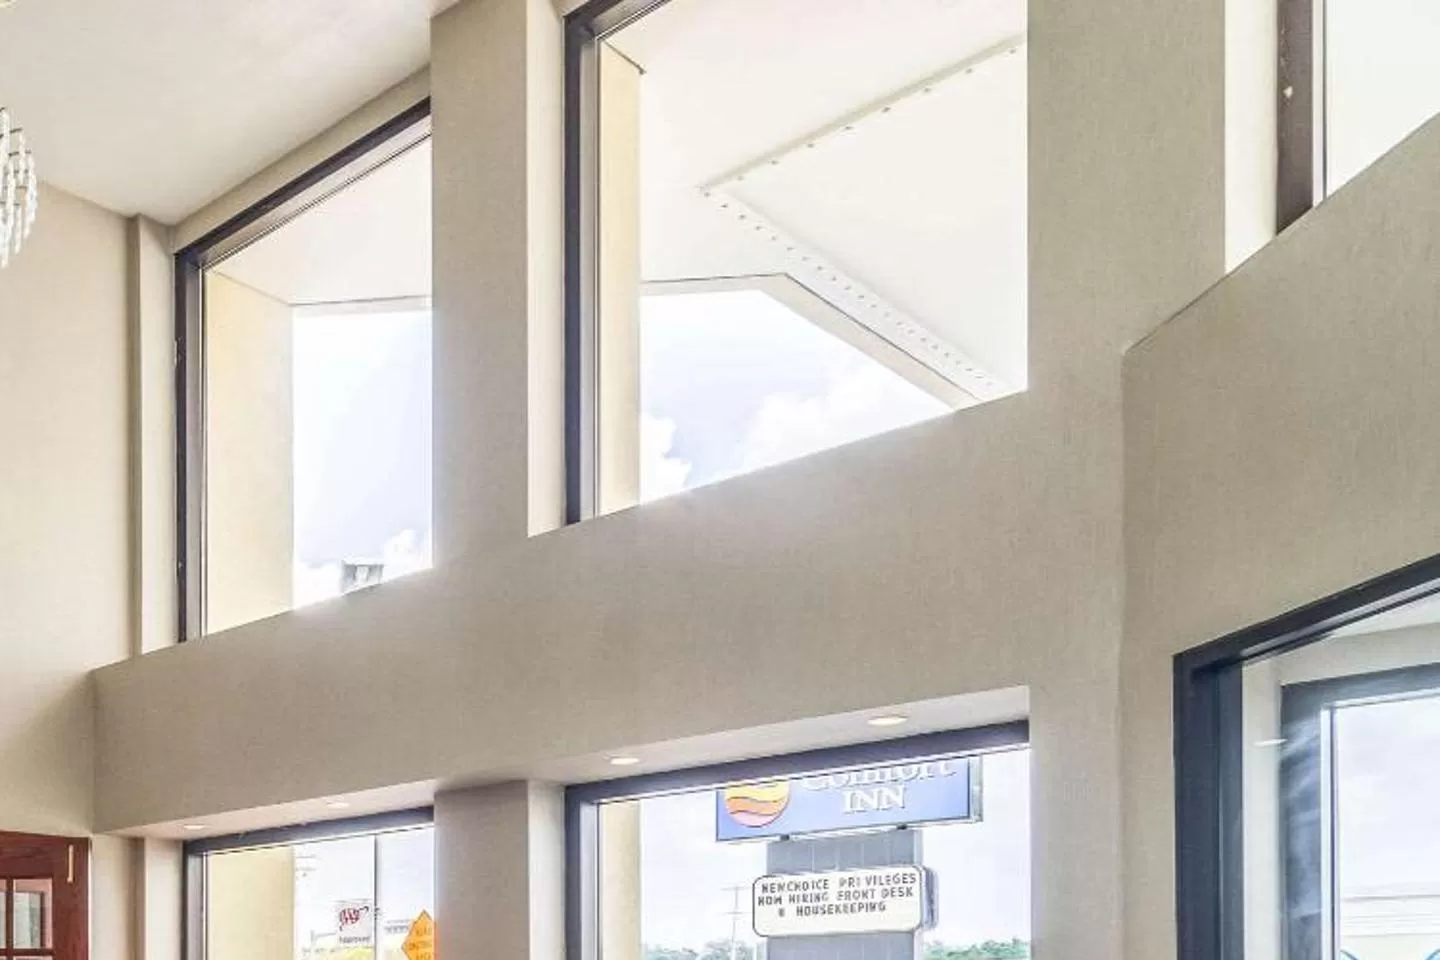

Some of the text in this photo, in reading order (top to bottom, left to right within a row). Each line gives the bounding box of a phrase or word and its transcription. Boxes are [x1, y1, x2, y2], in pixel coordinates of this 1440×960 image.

[843, 785, 906, 814] INN
[788, 891, 829, 904] HIRING
[880, 886, 913, 899] DESK
[796, 900, 886, 917] HOUSEKEEPING
